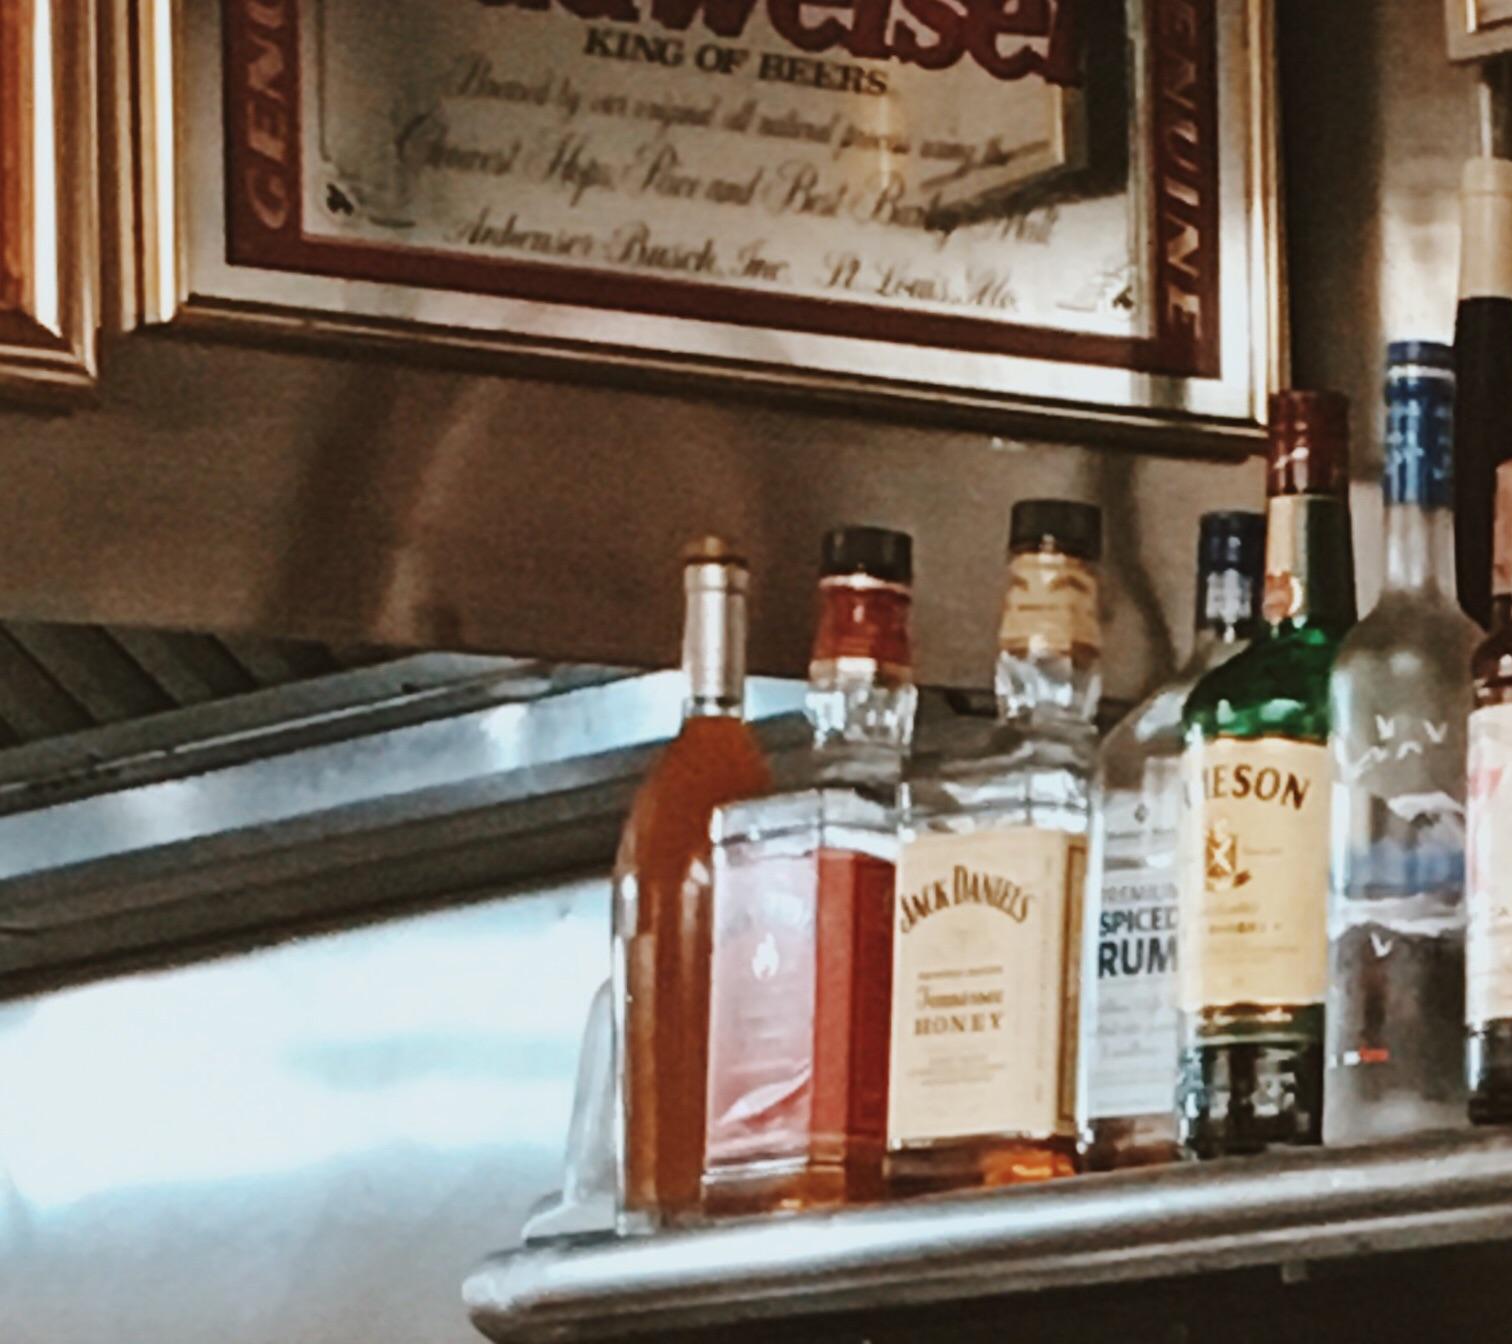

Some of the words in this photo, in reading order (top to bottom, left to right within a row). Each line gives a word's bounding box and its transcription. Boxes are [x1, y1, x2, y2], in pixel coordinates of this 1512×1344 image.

[583, 27, 685, 67] KING
[694, 43, 751, 74] OF
[757, 53, 890, 95] BEERS
[900, 879, 950, 934] JACK
[1096, 936, 1179, 979] RUM
[913, 1012, 1005, 1037] HONEY
